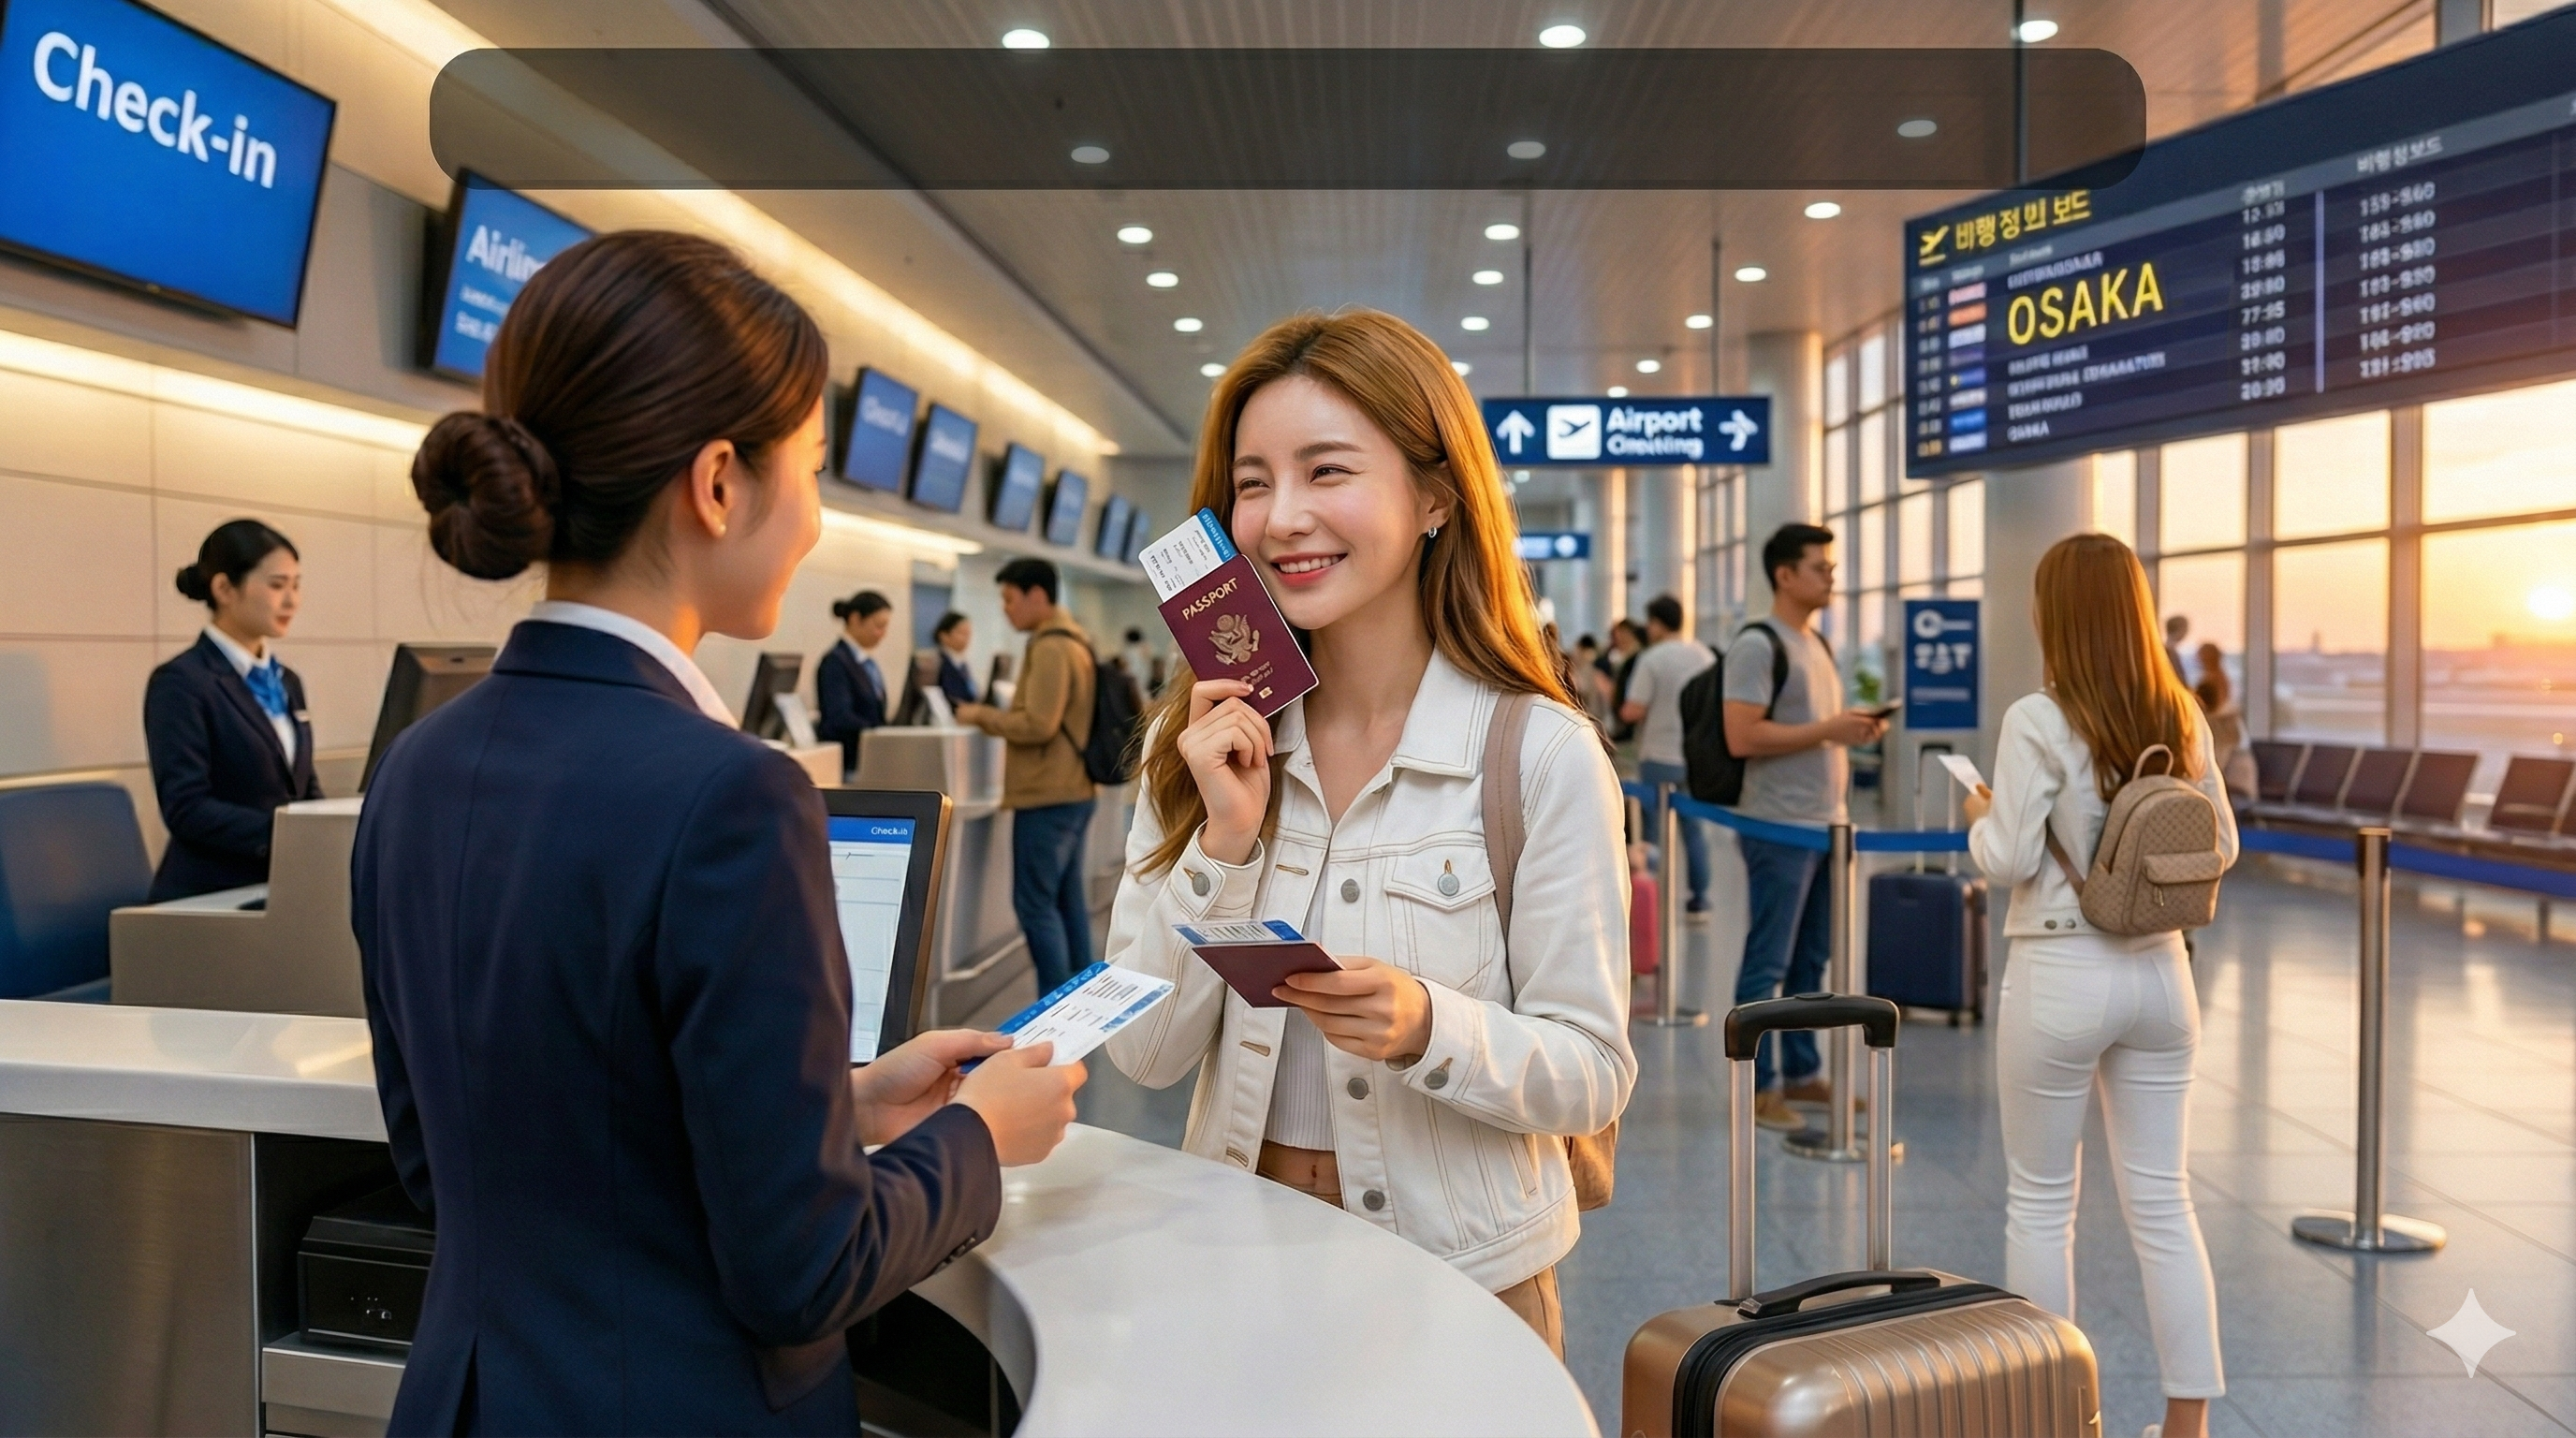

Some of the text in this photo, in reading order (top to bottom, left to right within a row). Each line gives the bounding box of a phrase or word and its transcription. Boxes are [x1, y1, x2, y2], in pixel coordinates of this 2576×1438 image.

[34, 31, 276, 189] Check-in
[465, 225, 546, 282] Airlin
[2008, 262, 2163, 345] OSAKA
[1606, 405, 1703, 439] Airport
[1181, 577, 1237, 621] PASSPORT
